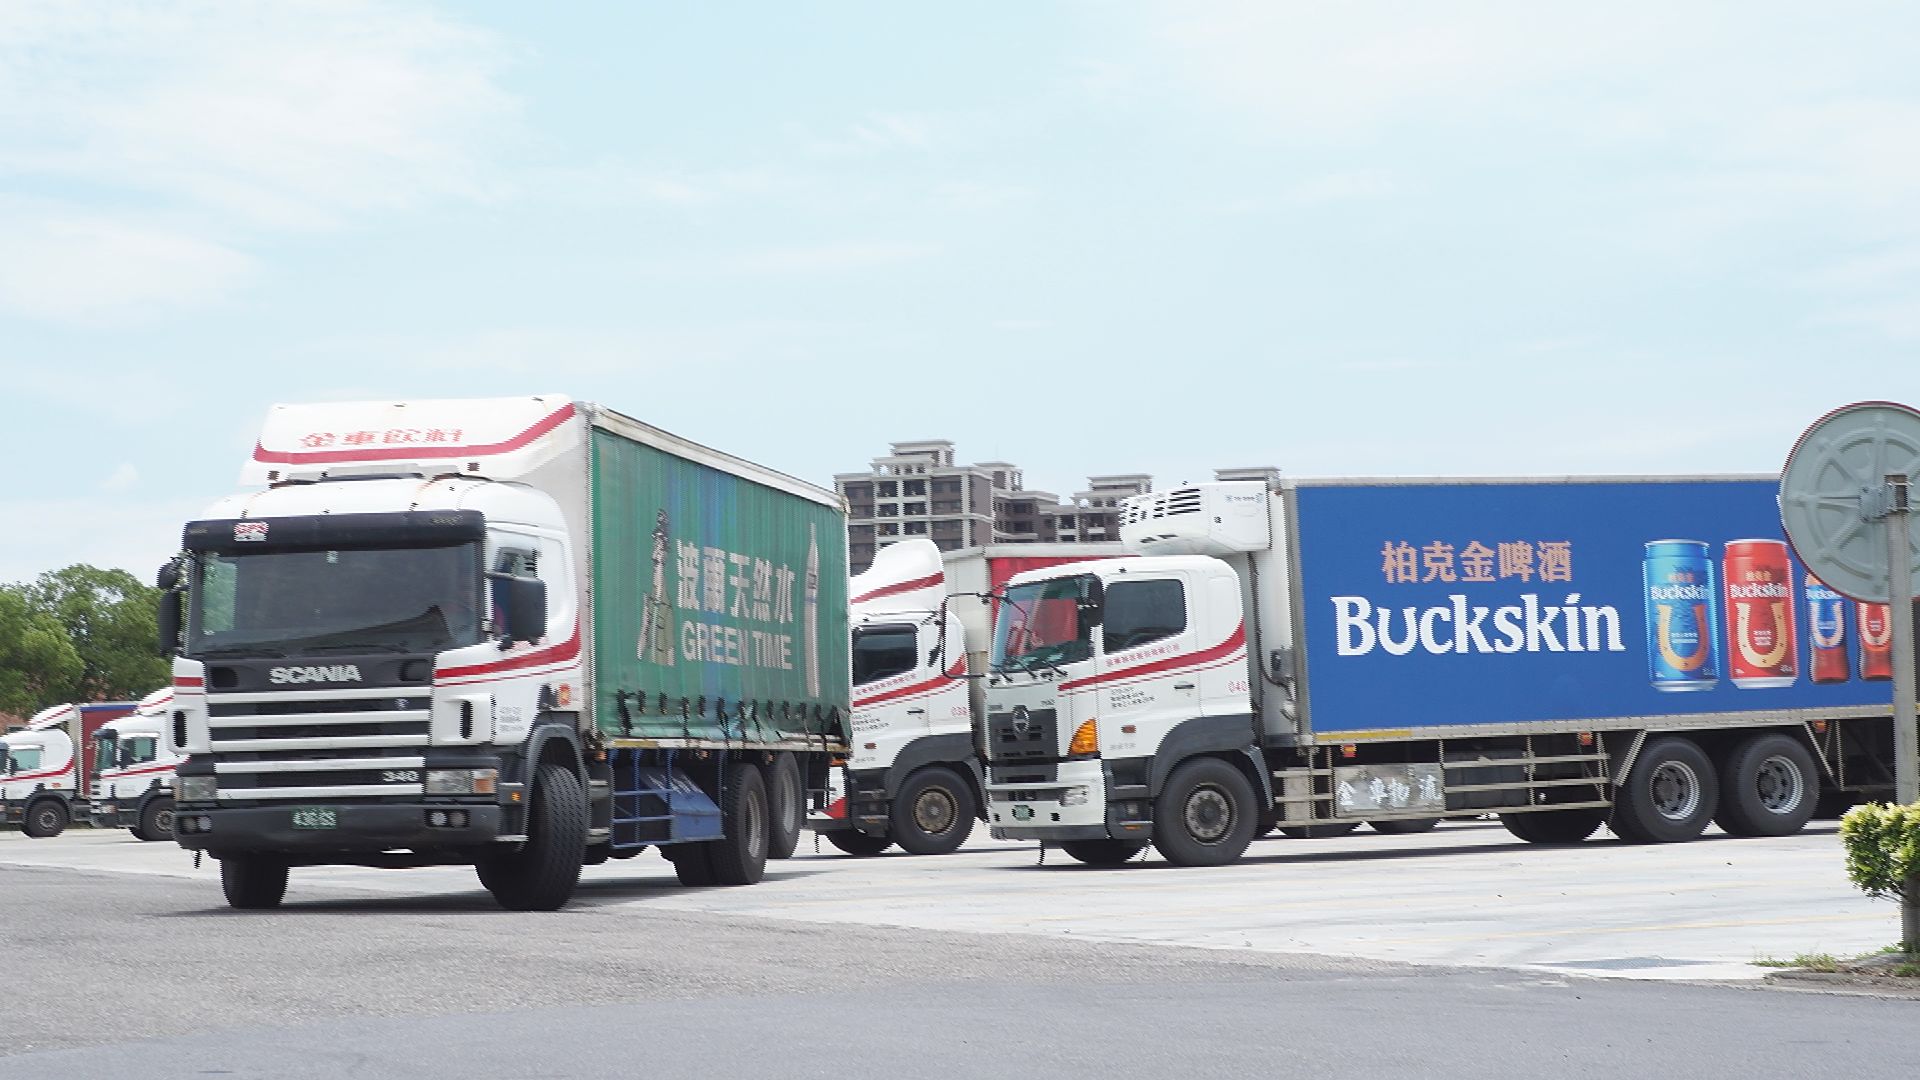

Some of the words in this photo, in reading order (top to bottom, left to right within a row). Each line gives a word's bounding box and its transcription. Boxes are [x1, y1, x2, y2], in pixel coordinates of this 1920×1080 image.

[1381, 540, 1572, 583] 柏克金啤酒
[1730, 583, 1789, 599] Buckskin
[1330, 593, 1626, 655] Buckskin
[681, 621, 749, 666] GREEN
[752, 630, 793, 670] TIME
[269, 665, 362, 684] SCANIA
[383, 771, 420, 782] 340
